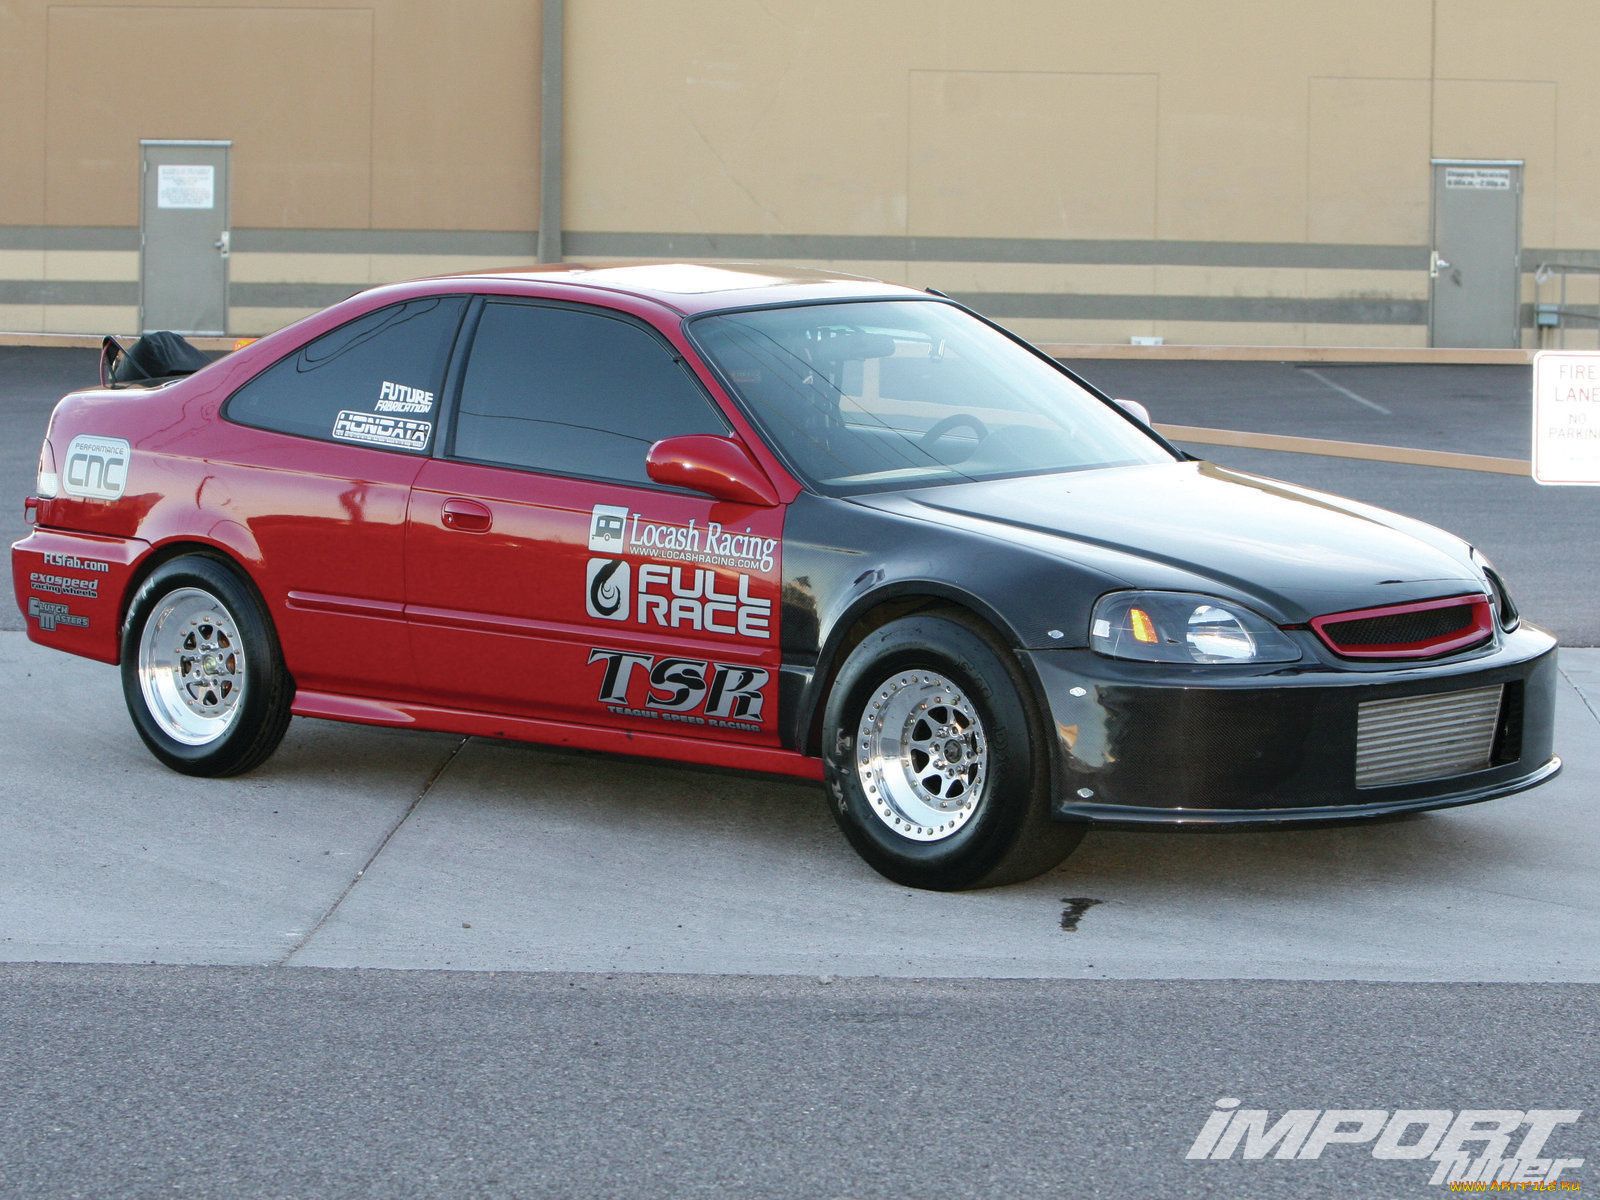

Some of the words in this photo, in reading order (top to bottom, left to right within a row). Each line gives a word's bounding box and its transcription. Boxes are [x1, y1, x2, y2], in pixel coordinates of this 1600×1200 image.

[1559, 364, 1598, 380] FIRE
[379, 380, 434, 406] FUTURE
[1554, 385, 1600, 402] LANE
[374, 399, 432, 414] FABRICATION
[336, 412, 429, 442] HONDATA
[1568, 412, 1588, 425] NO
[1548, 427, 1600, 440] PARKIN
[74, 442, 125, 456] PERFORMANCE
[629, 513, 700, 555] Locash
[704, 521, 778, 574] Racing
[43, 552, 109, 573] FCSfab.com
[629, 545, 761, 570] WWW.LOCASHRACING.COM
[30, 572, 99, 590] exospeed
[30, 581, 62, 595] racing
[62, 586, 98, 599] wheels
[638, 562, 772, 608] FULL
[28, 597, 69, 619] CLUTCH
[637, 592, 772, 639] RACE
[39, 612, 90, 632] MASTERS
[586, 647, 771, 723] TSR
[607, 704, 659, 720] TEAGUE
[661, 711, 706, 726] SPEED
[708, 718, 762, 733] RACING
